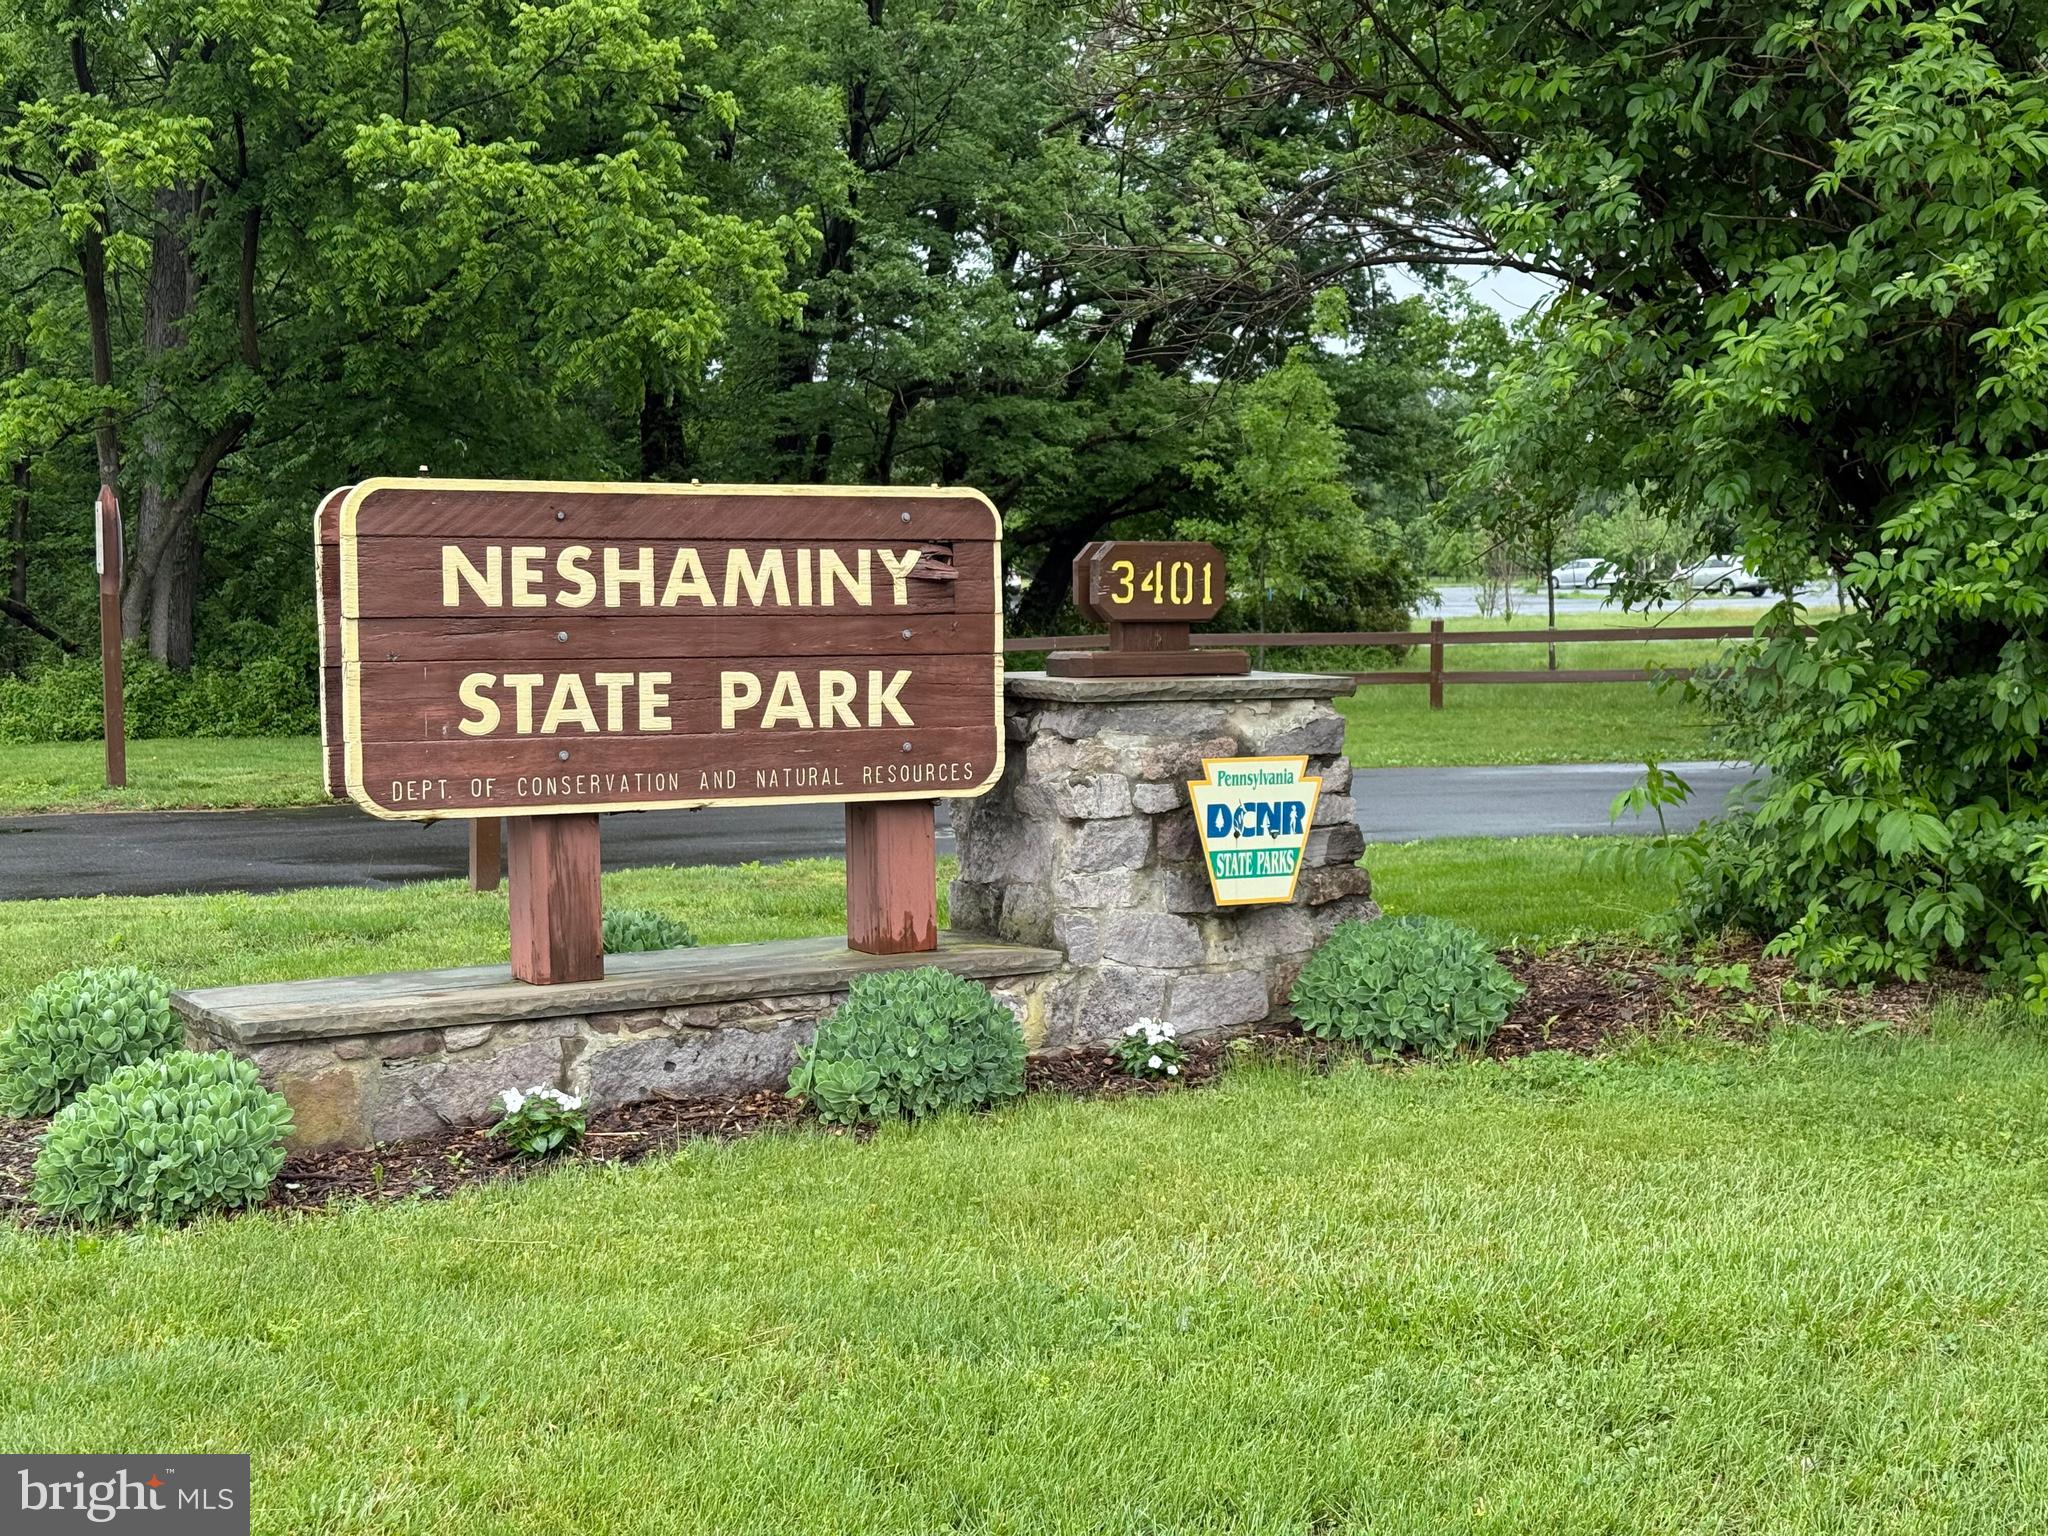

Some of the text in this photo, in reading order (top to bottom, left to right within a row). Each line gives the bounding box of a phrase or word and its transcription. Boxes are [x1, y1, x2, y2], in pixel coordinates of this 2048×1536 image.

[441, 545, 922, 608] NESHAMINY
[1111, 560, 1213, 605] 3401
[458, 670, 914, 736] STATE PARK
[392, 762, 974, 802] DEPT. OF CONSERVATION AND NATURAL RESOURCES
[1217, 769, 1294, 790] Pennsylvania
[1206, 800, 1306, 839] DCNR
[1216, 850, 1295, 877] STATE PARKS
